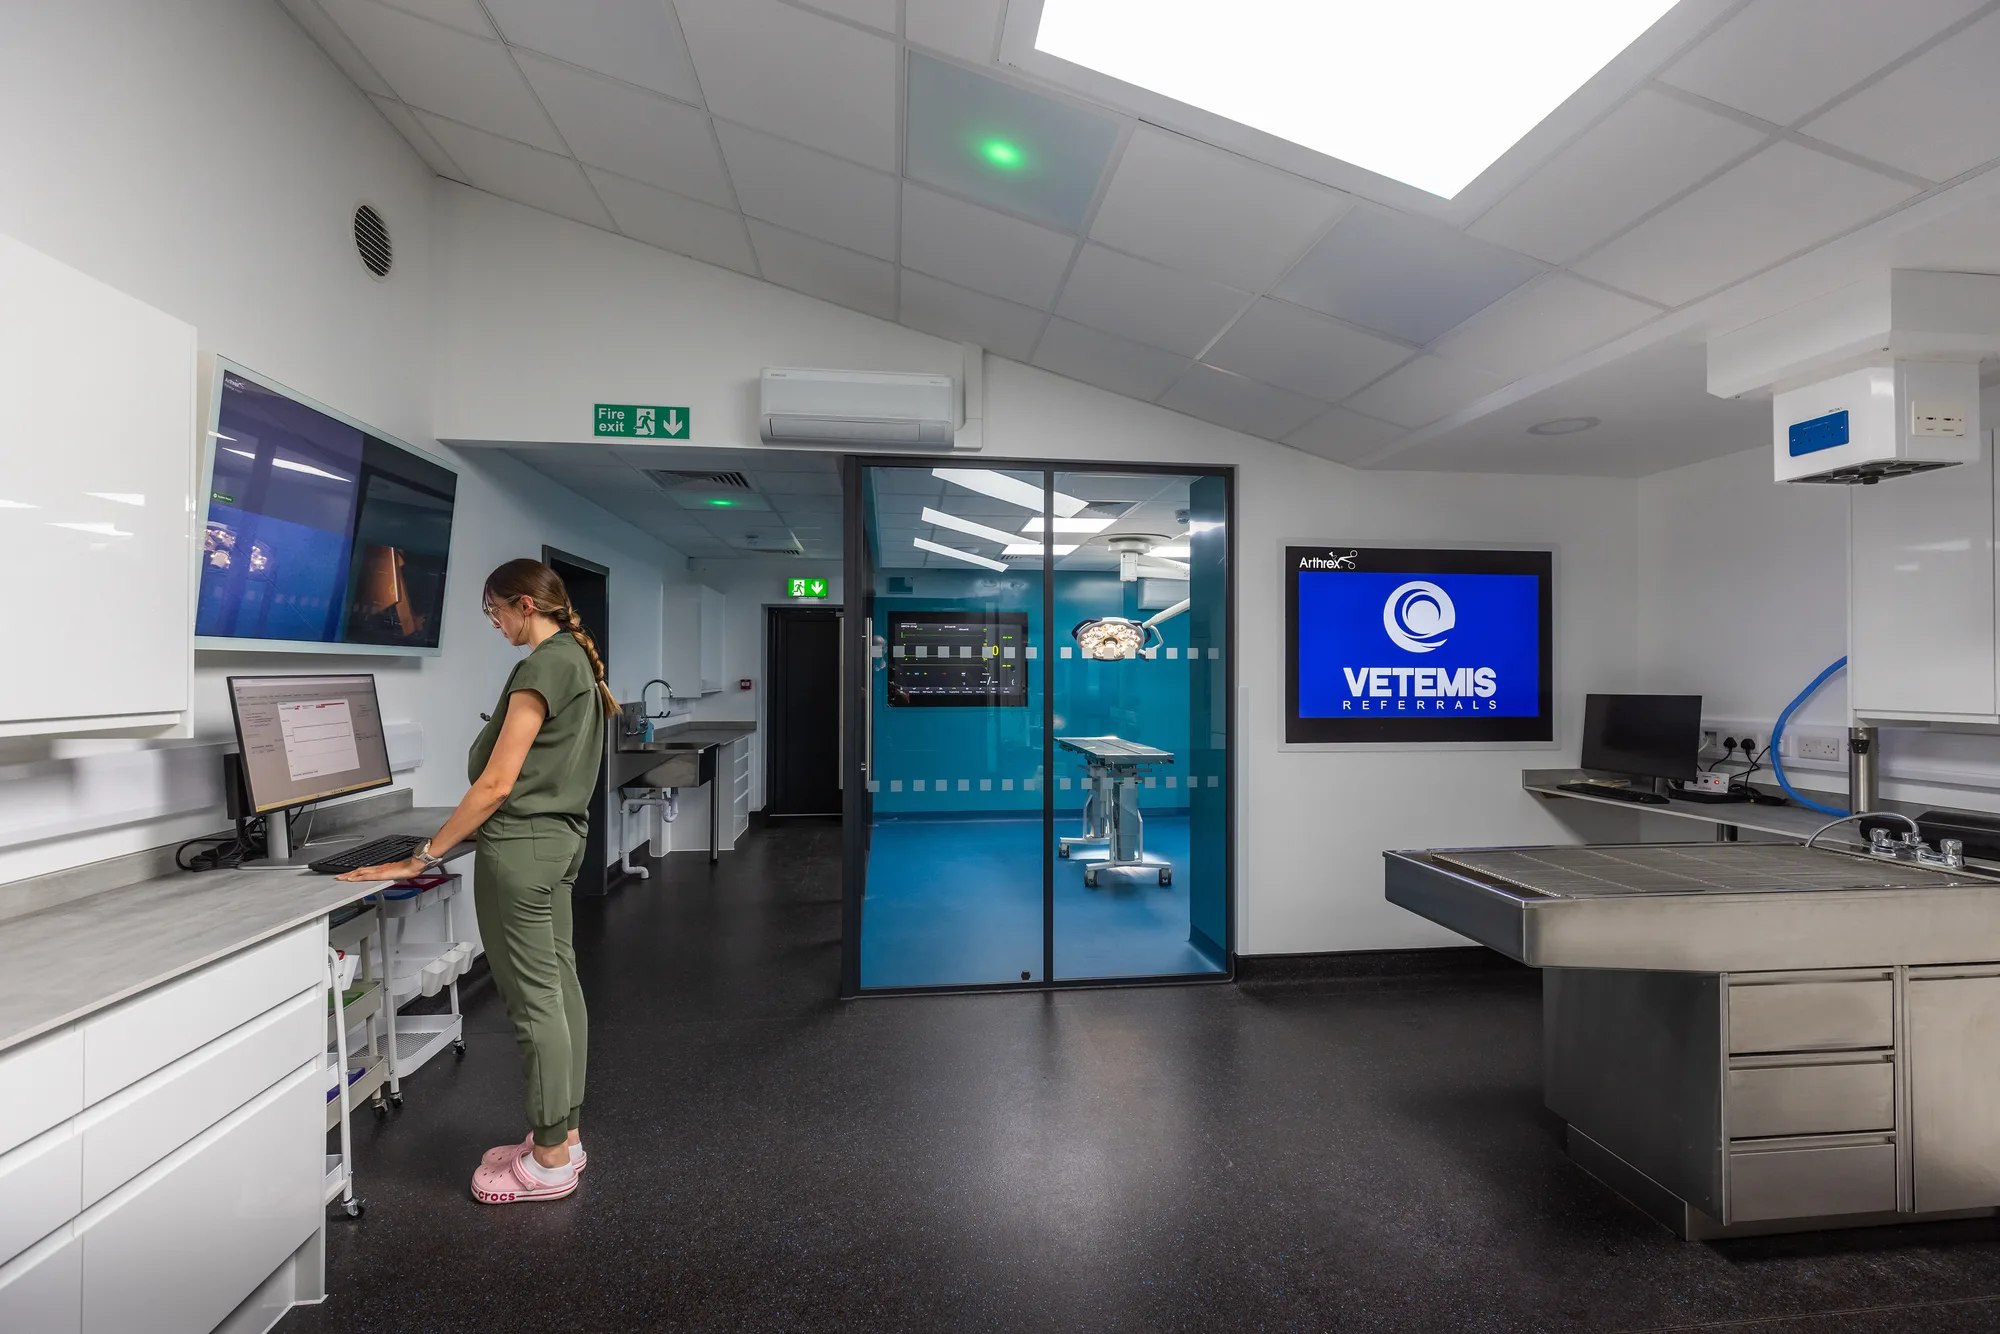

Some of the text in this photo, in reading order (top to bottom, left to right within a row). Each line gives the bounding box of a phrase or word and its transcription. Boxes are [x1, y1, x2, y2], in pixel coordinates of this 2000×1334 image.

[598, 407, 625, 420] Fire
[599, 421, 625, 432] exit
[1299, 556, 1341, 569] Arthrex
[1343, 667, 1497, 698] VETEMIS
[1343, 700, 1497, 710] REFERRALS
[478, 1191, 516, 1202] crocs
